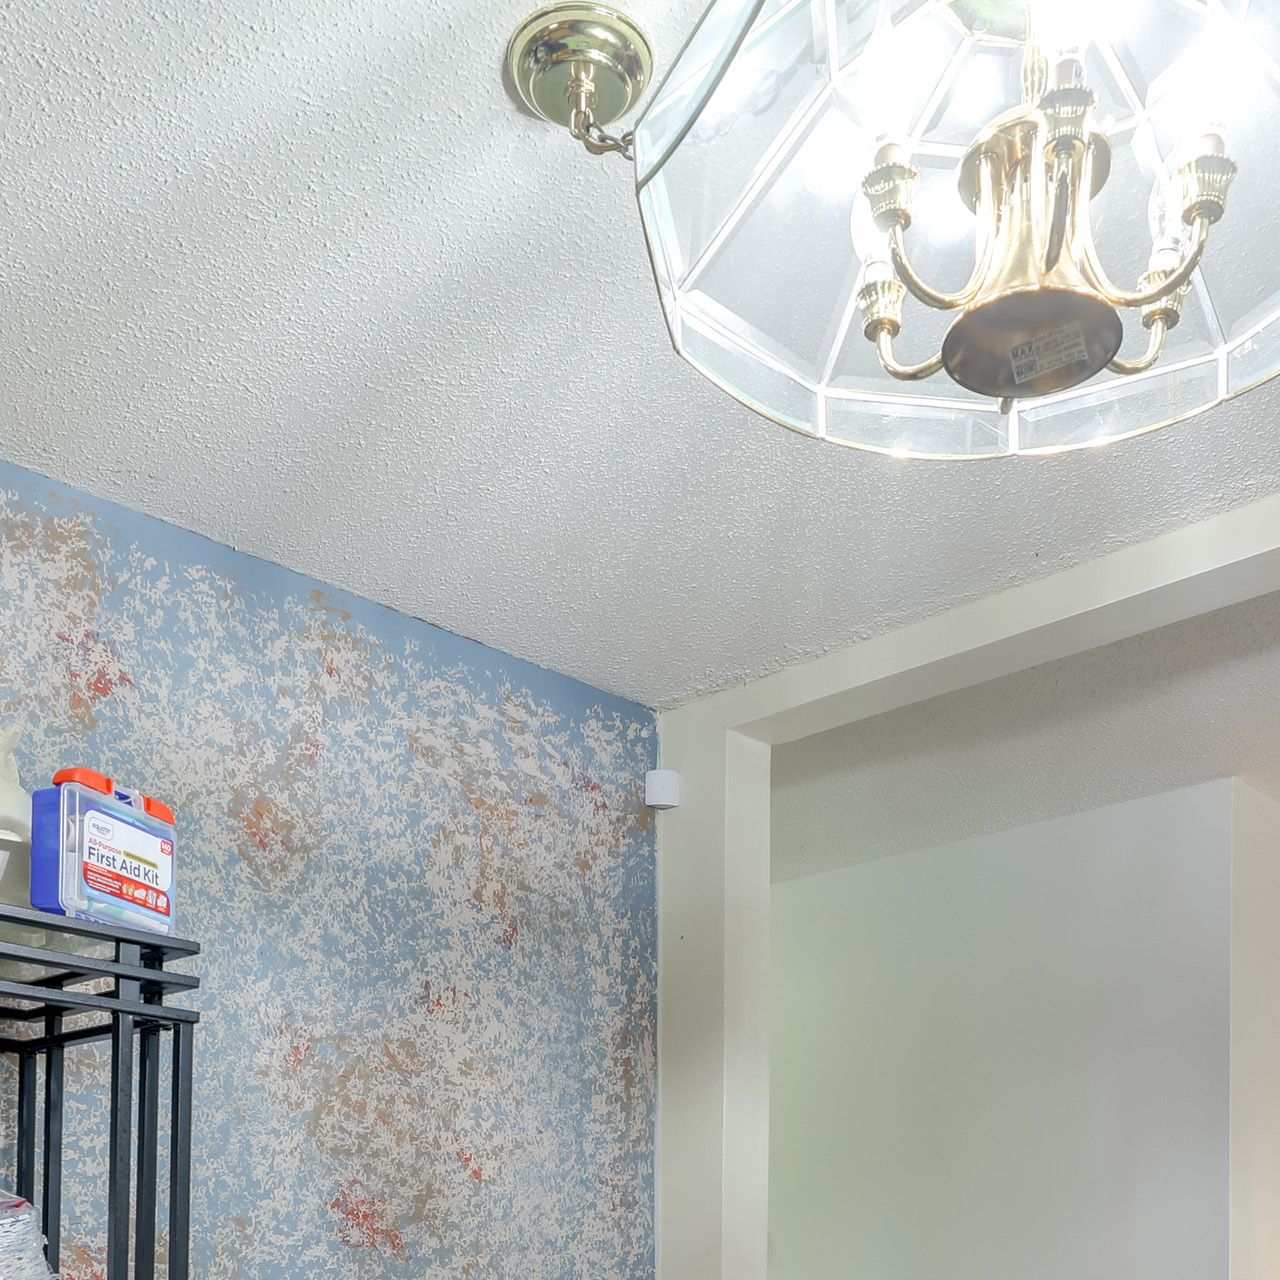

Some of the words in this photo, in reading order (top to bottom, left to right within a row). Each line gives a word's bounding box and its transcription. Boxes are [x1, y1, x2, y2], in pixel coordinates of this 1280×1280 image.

[88, 846, 117, 869] First
[120, 859, 140, 878] Aid
[143, 867, 159, 886] Kit
